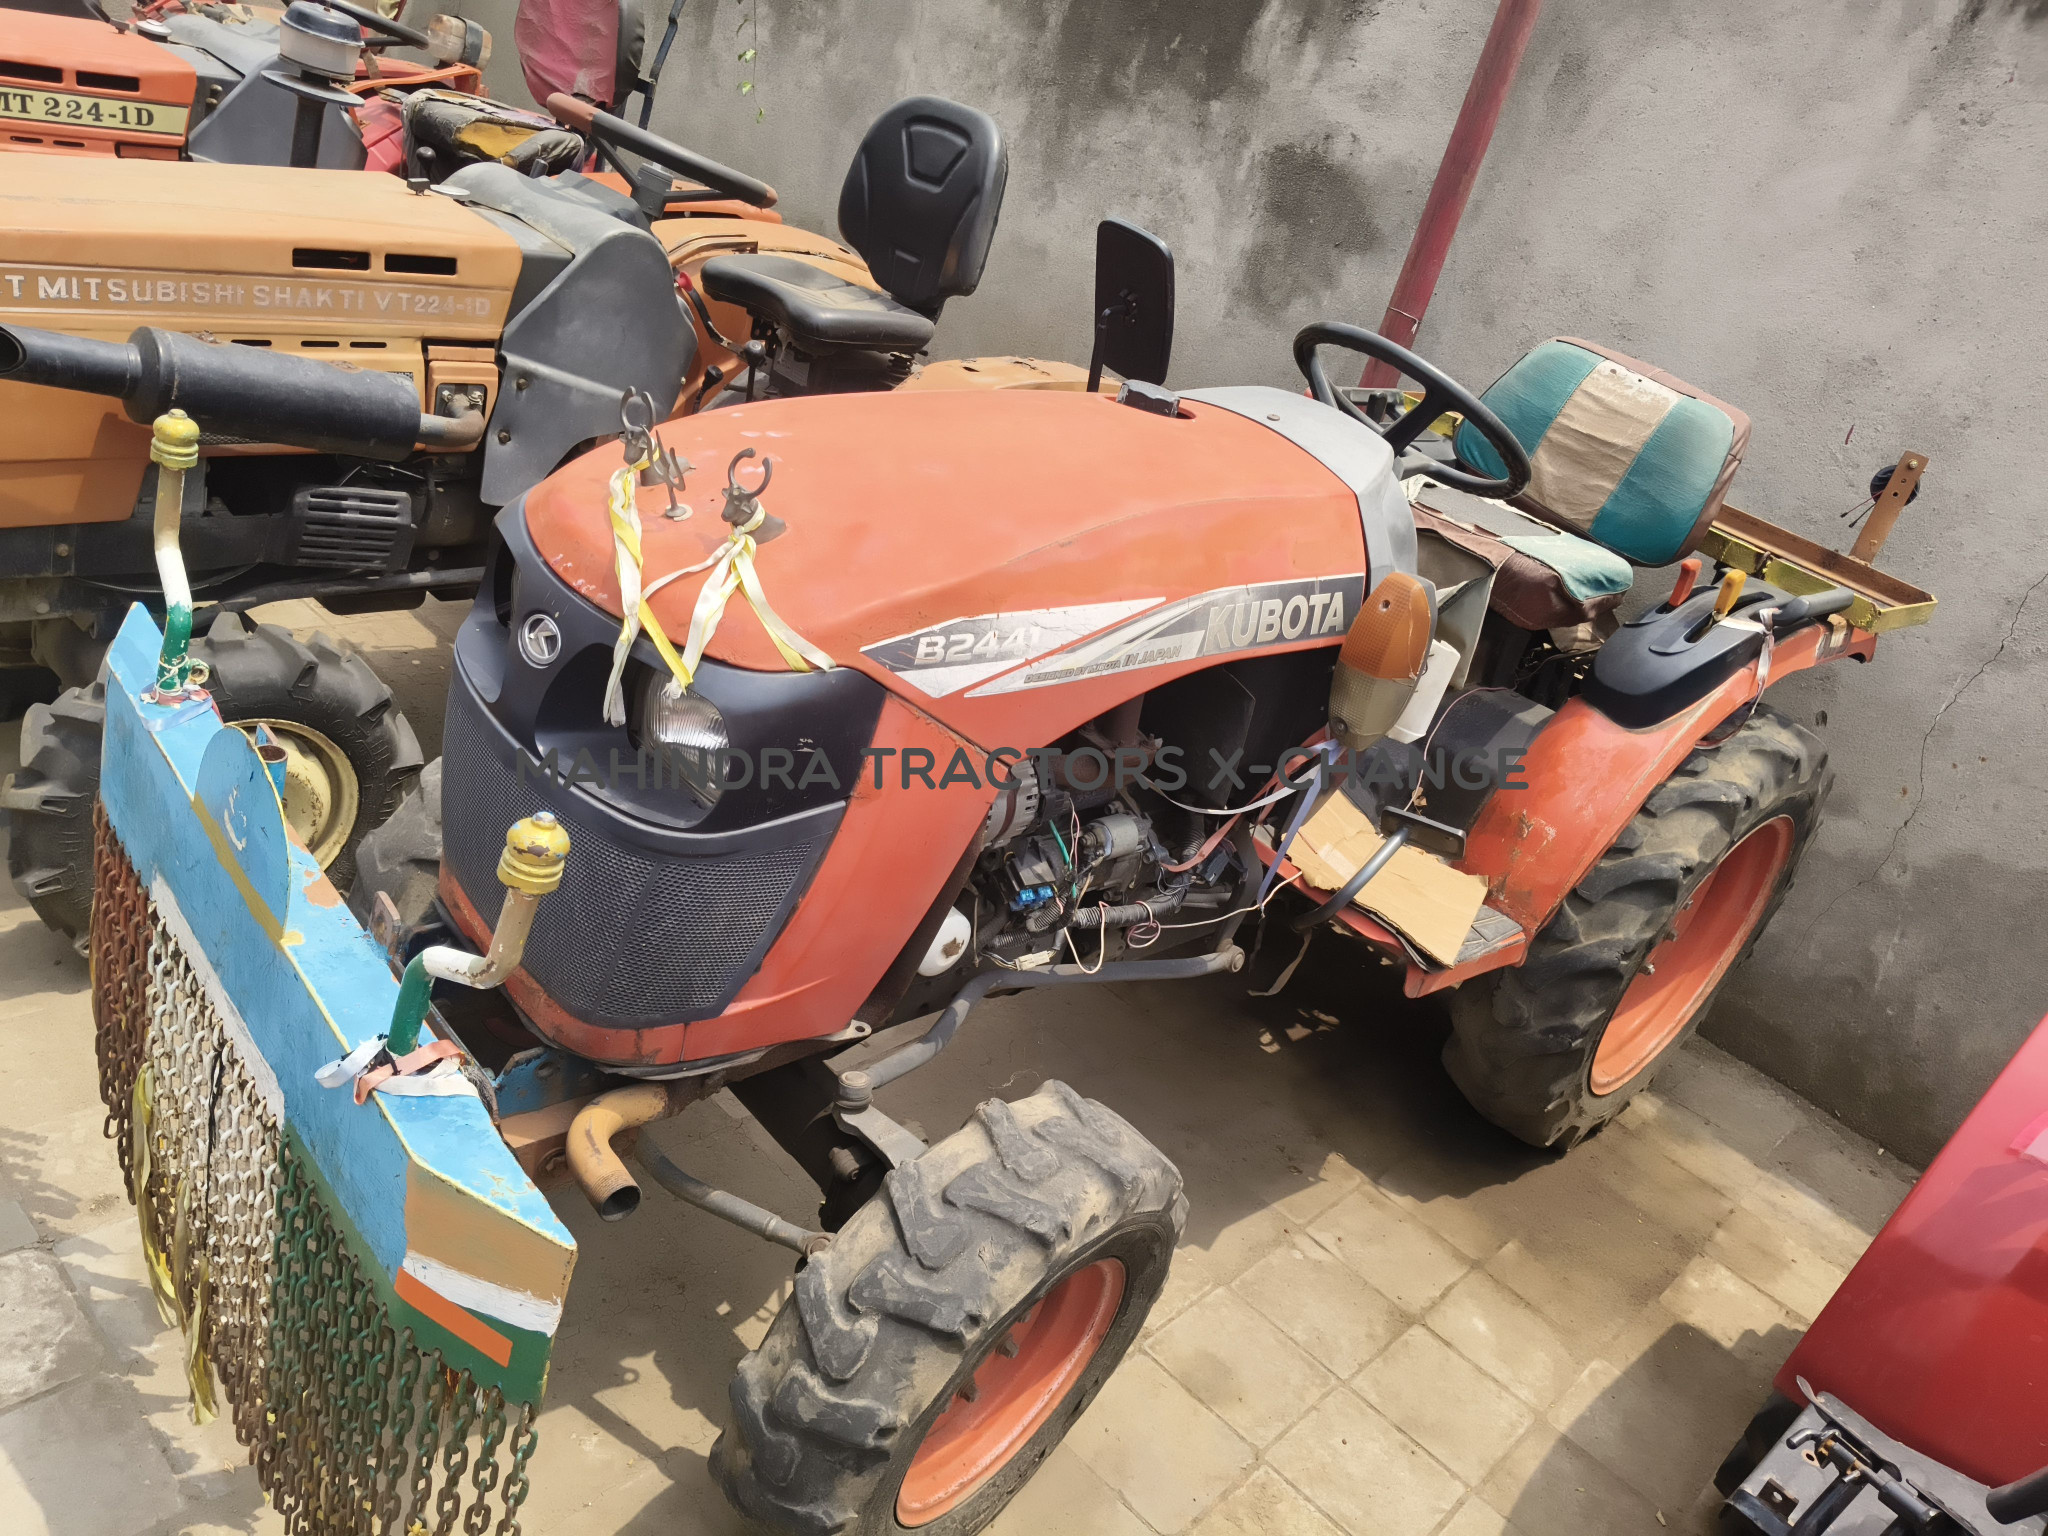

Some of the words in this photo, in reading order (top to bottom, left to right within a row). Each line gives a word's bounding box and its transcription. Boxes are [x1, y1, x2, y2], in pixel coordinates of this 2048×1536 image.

[44, 97, 154, 126] 224-1D
[38, 276, 244, 304] MITSUBISHI
[253, 285, 364, 310] SHAKTI
[1204, 592, 1344, 649] KUBOTA
[914, 625, 1041, 666] B2441
[1024, 668, 1074, 683] DESIGNED
[1074, 666, 1088, 676] BY
[1087, 661, 1121, 674] KUBOTA
[1122, 653, 1139, 668] IN
[1138, 645, 1182, 664] JAPAN
